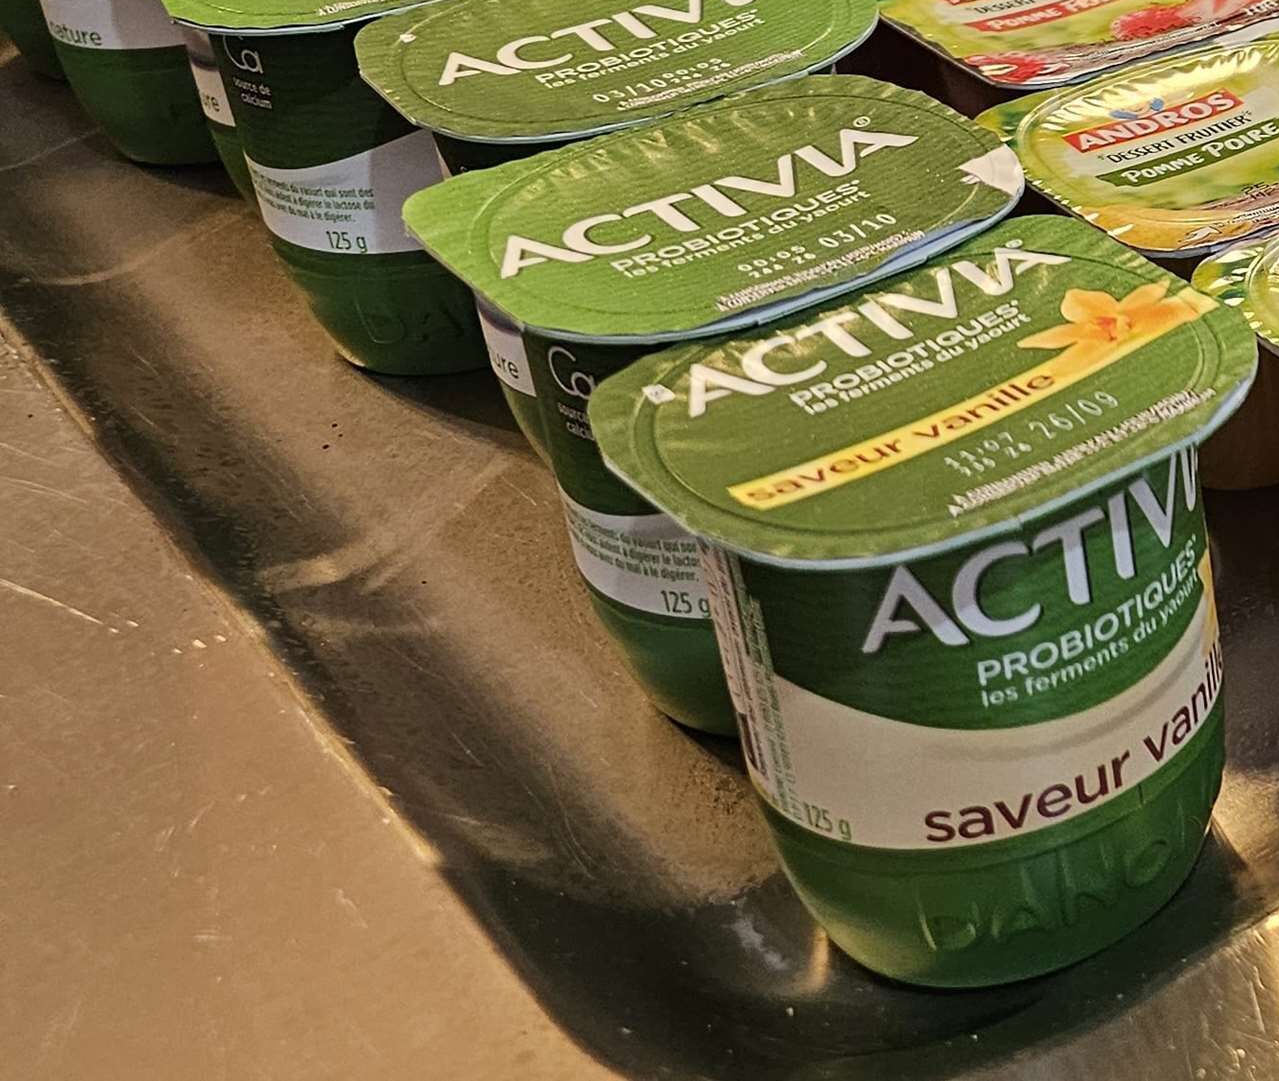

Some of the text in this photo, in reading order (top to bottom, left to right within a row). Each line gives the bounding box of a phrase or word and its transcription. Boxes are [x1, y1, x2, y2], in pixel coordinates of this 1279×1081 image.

[535, 10, 757, 84] PROBIOTIQUES
[986, 6, 1063, 31] POMME
[1078, 94, 1237, 151] ANDROS
[1108, 112, 1250, 165] DESSERT FRUITIER
[500, 128, 919, 279] ACTIVIA
[1120, 150, 1205, 185] POMME
[326, 230, 368, 254] 125 g
[610, 180, 858, 273] PROBIOTIQUES
[660, 232, 767, 271] ferments
[768, 220, 798, 236] du
[801, 191, 871, 226] yaourt
[818, 213, 897, 250] 03/10
[688, 248, 1072, 418] ACTIVIA
[789, 304, 1017, 408] PROBIOTIQUES
[831, 360, 935, 407] ferments
[936, 341, 965, 362] du
[966, 313, 1033, 352] yaourt
[744, 439, 903, 503] saveur
[913, 372, 1058, 441] vanille
[661, 590, 692, 614] 125
[977, 545, 1194, 686] PROBIOTIQUES
[982, 678, 1018, 708] les
[1025, 640, 1129, 696] ferments
[1134, 618, 1157, 644] du
[803, 801, 853, 841] 125 g
[924, 751, 1131, 843] saveur
